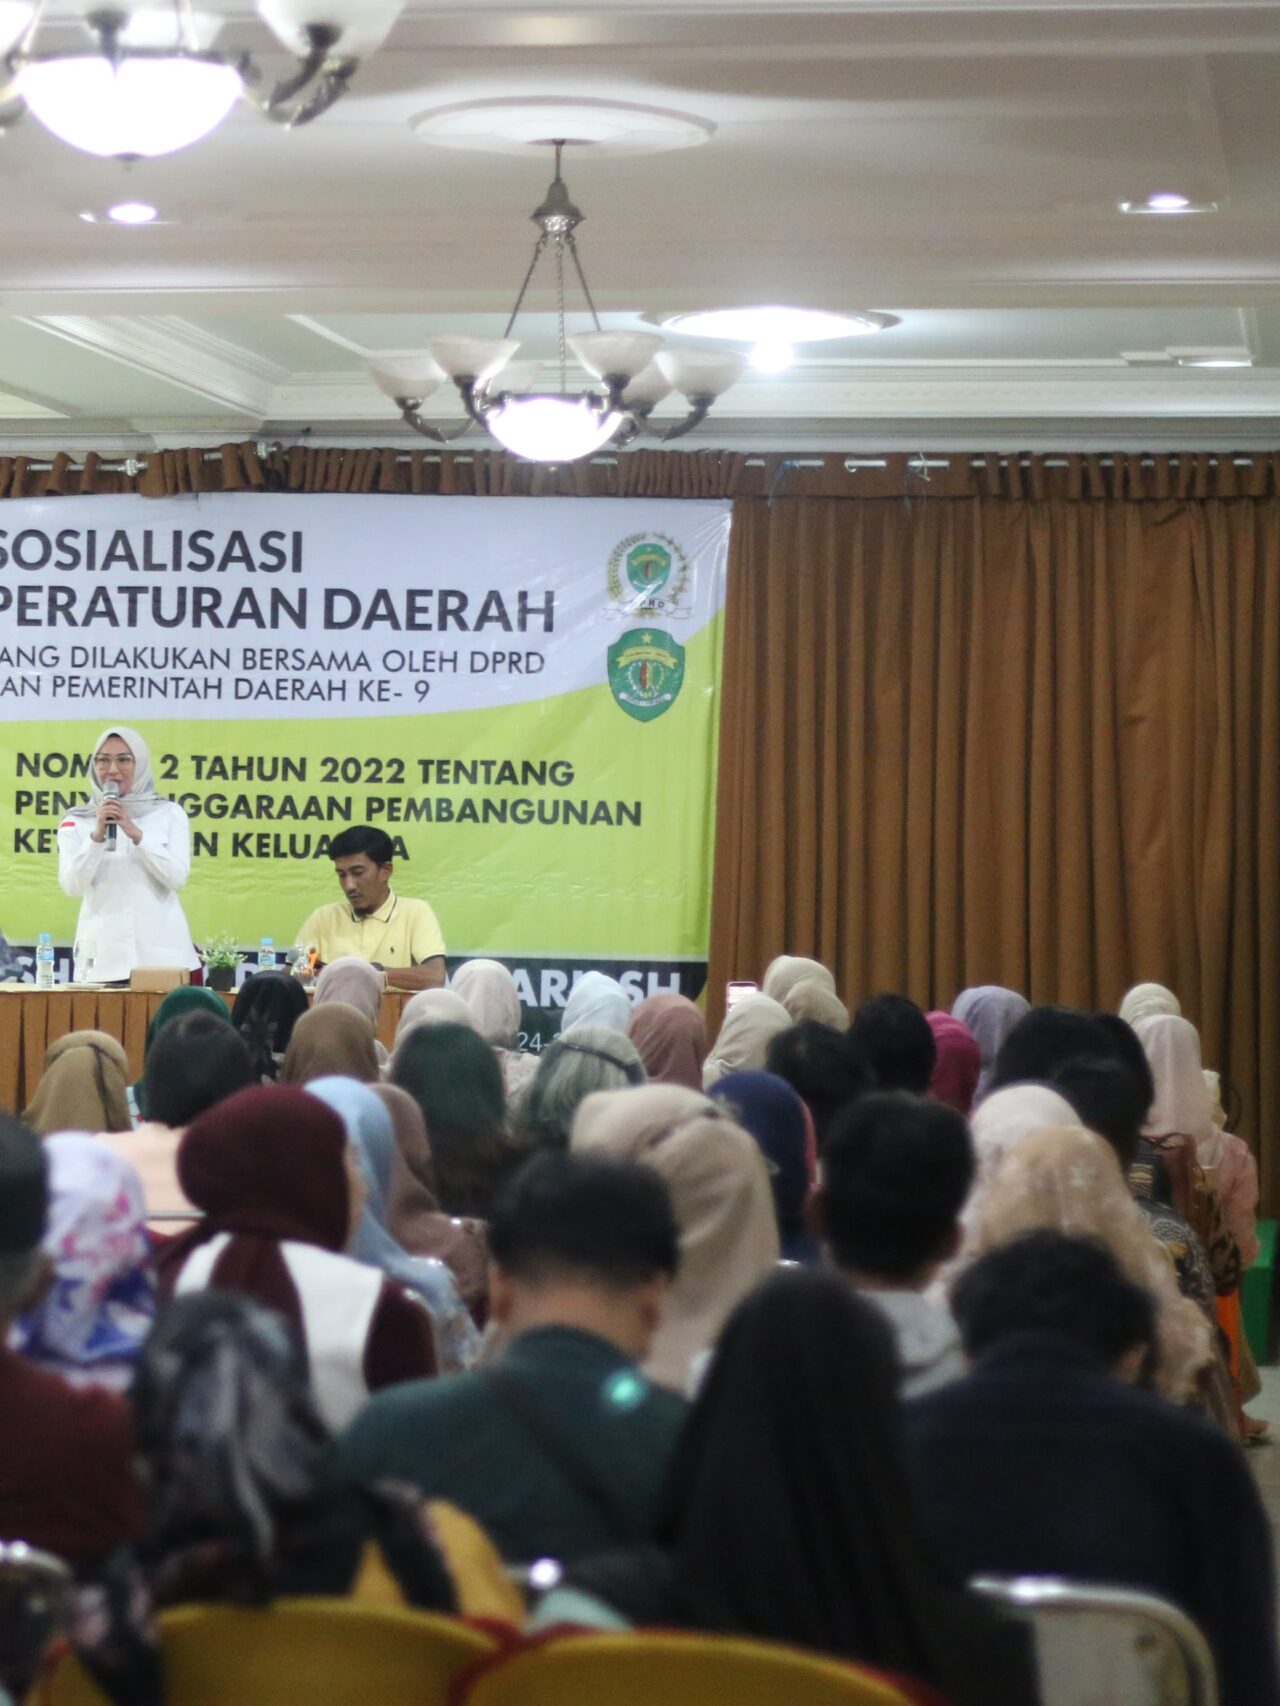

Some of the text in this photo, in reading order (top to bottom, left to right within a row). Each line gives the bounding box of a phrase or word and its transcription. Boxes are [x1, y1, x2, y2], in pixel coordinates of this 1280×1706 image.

[323, 588, 555, 633] DAERAH
[71, 646, 231, 670] DILAKUKAN
[243, 648, 372, 672] BERSAMA
[382, 649, 458, 673] OLEH
[470, 651, 545, 674] DPRD
[52, 675, 222, 699] PEMERINTAH
[234, 678, 346, 702] DAERAH
[359, 680, 403, 701] KE-
[414, 680, 430, 703] 9
[16, 752, 575, 787] NOM 2 TAHUN 2022 TENTANG
[366, 797, 642, 826] PEMBANGUNAN
[232, 833, 410, 860] KELUAA
